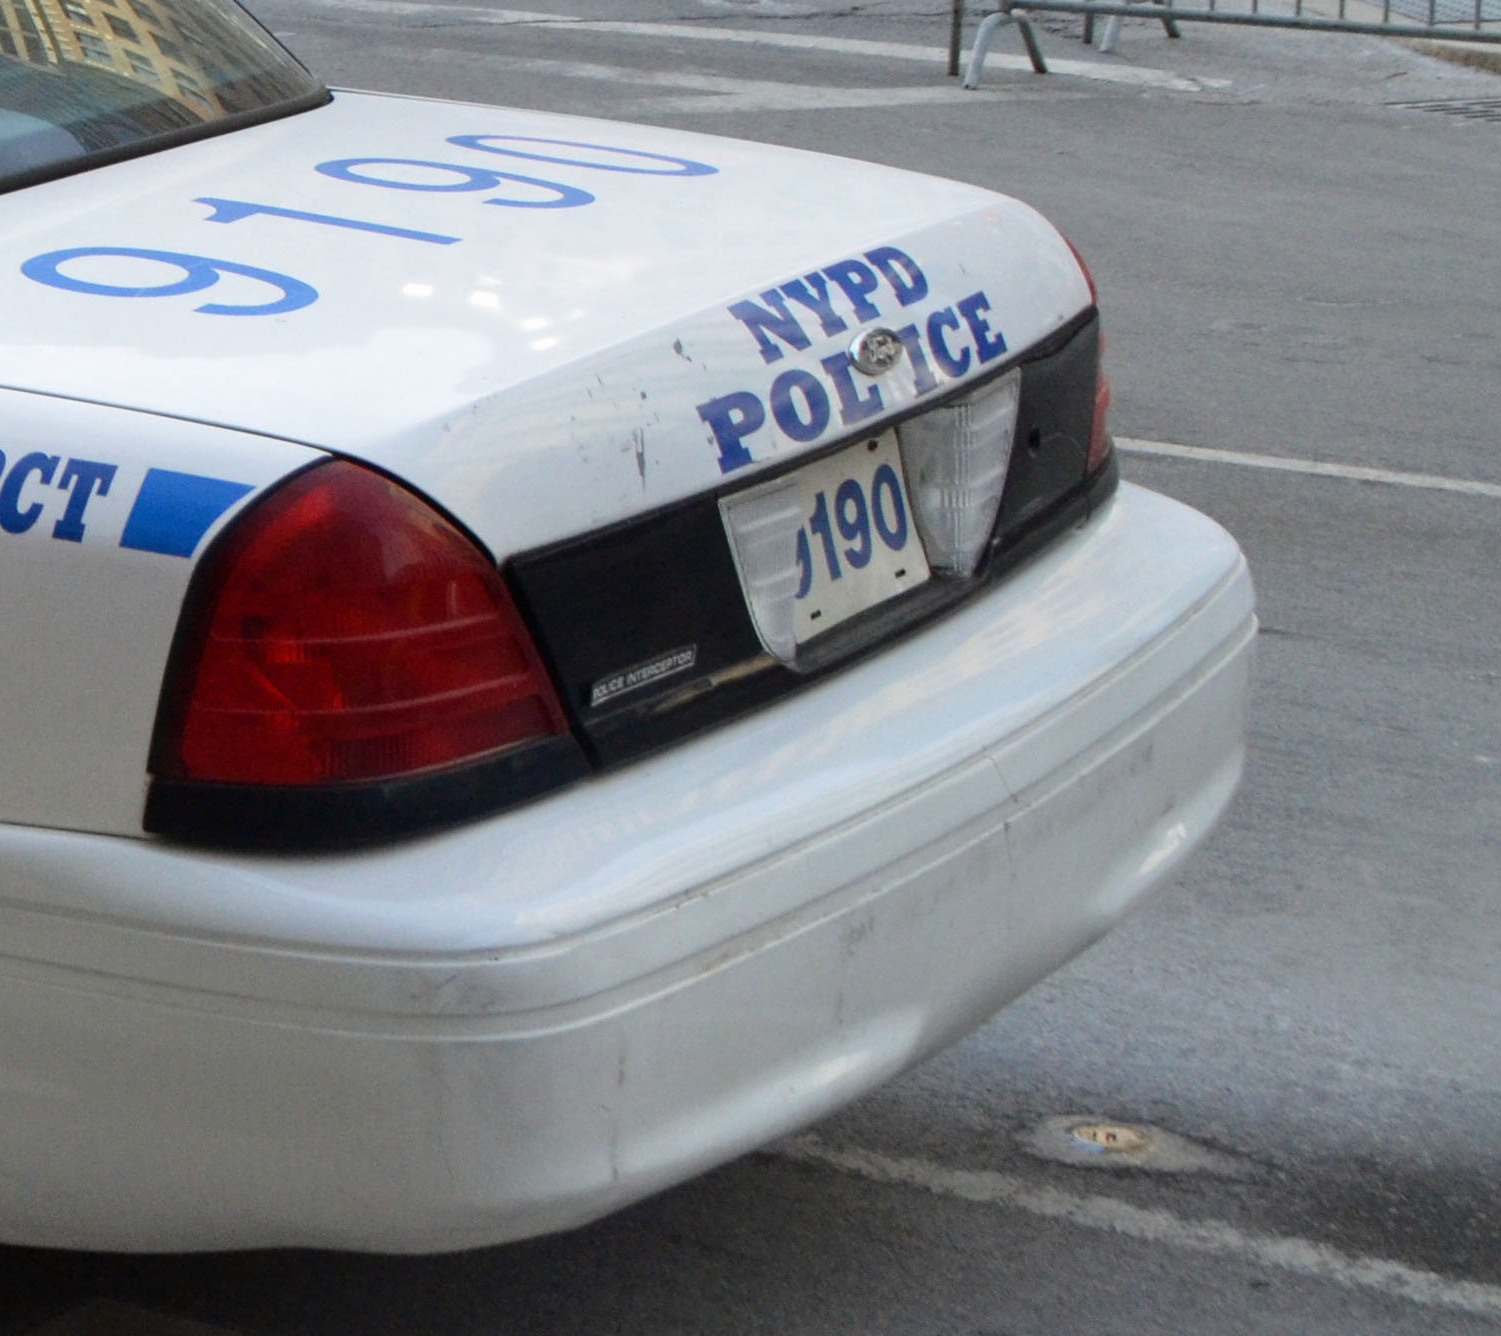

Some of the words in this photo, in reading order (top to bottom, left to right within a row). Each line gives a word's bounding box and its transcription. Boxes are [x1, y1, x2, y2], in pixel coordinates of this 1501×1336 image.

[20, 135, 718, 317] 9190
[727, 245, 929, 363] NYPD
[697, 291, 1008, 474] POLICE
